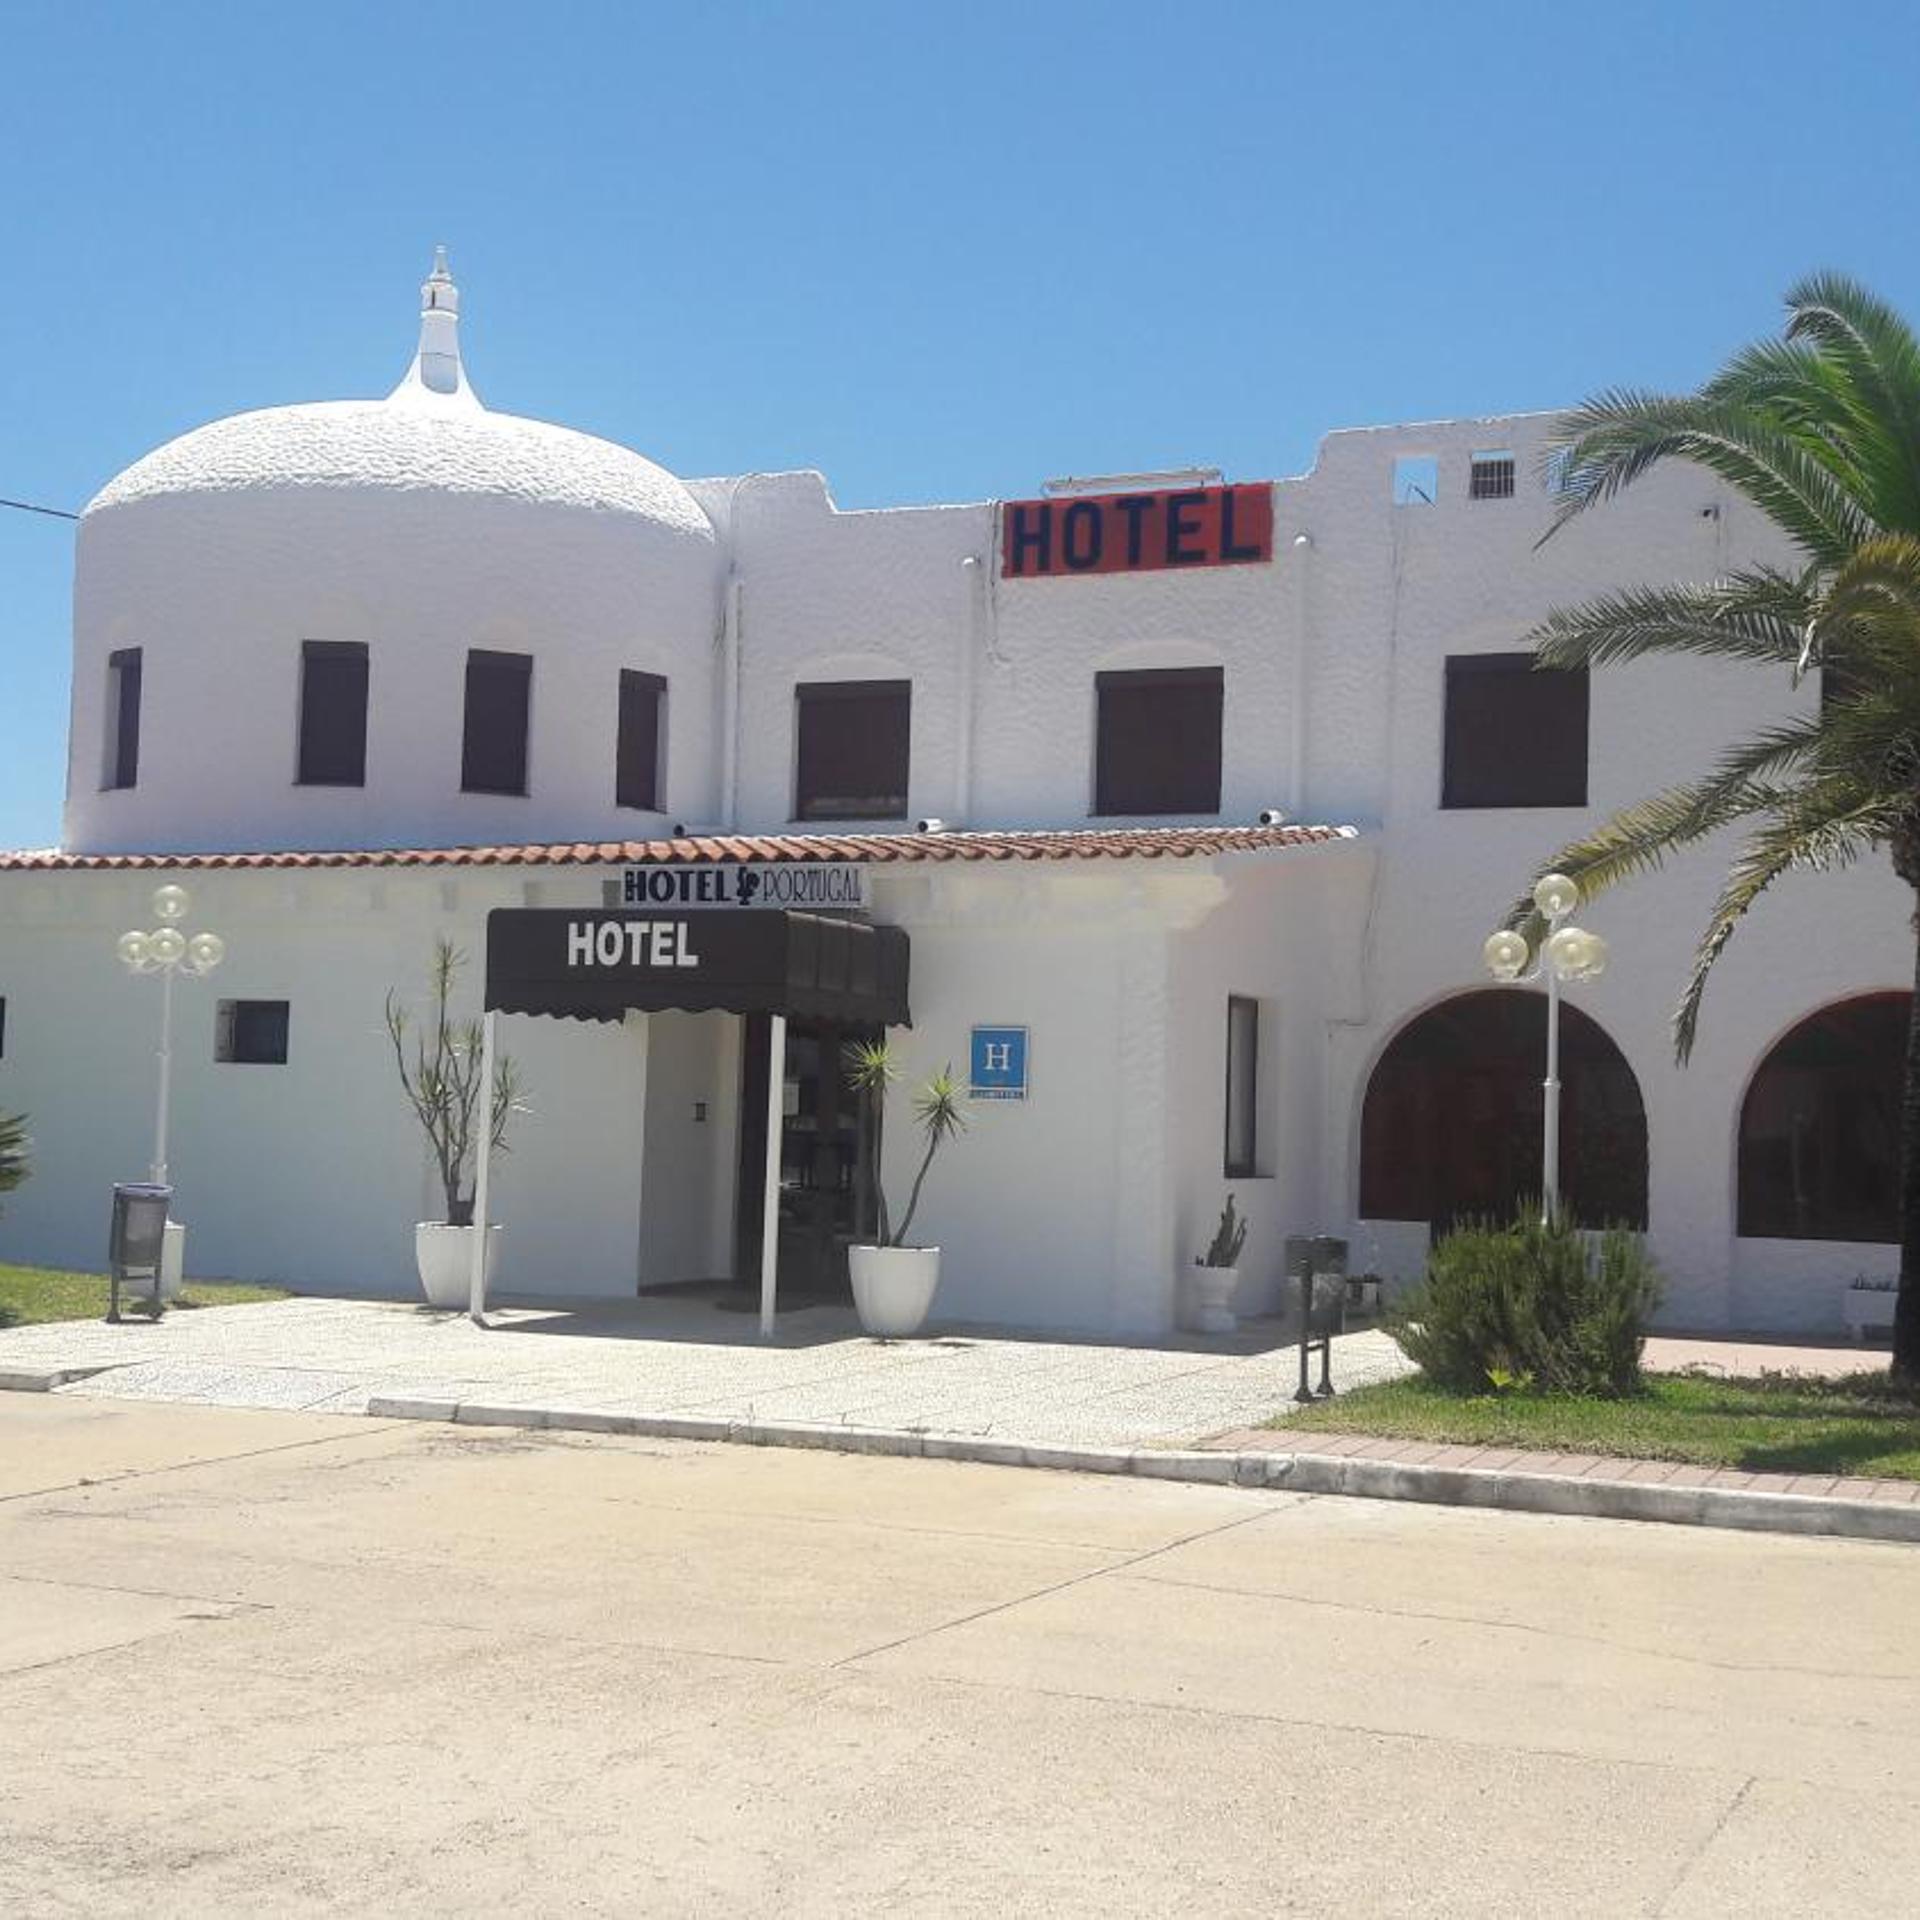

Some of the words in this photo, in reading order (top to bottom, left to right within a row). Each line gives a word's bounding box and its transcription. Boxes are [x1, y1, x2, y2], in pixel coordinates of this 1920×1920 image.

[1011, 491, 1261, 577] HOTEL
[625, 870, 732, 902] HOTEL
[763, 868, 861, 902] PORTUGAL
[568, 922, 699, 967] HOTEL
[984, 1043, 1011, 1070] H
